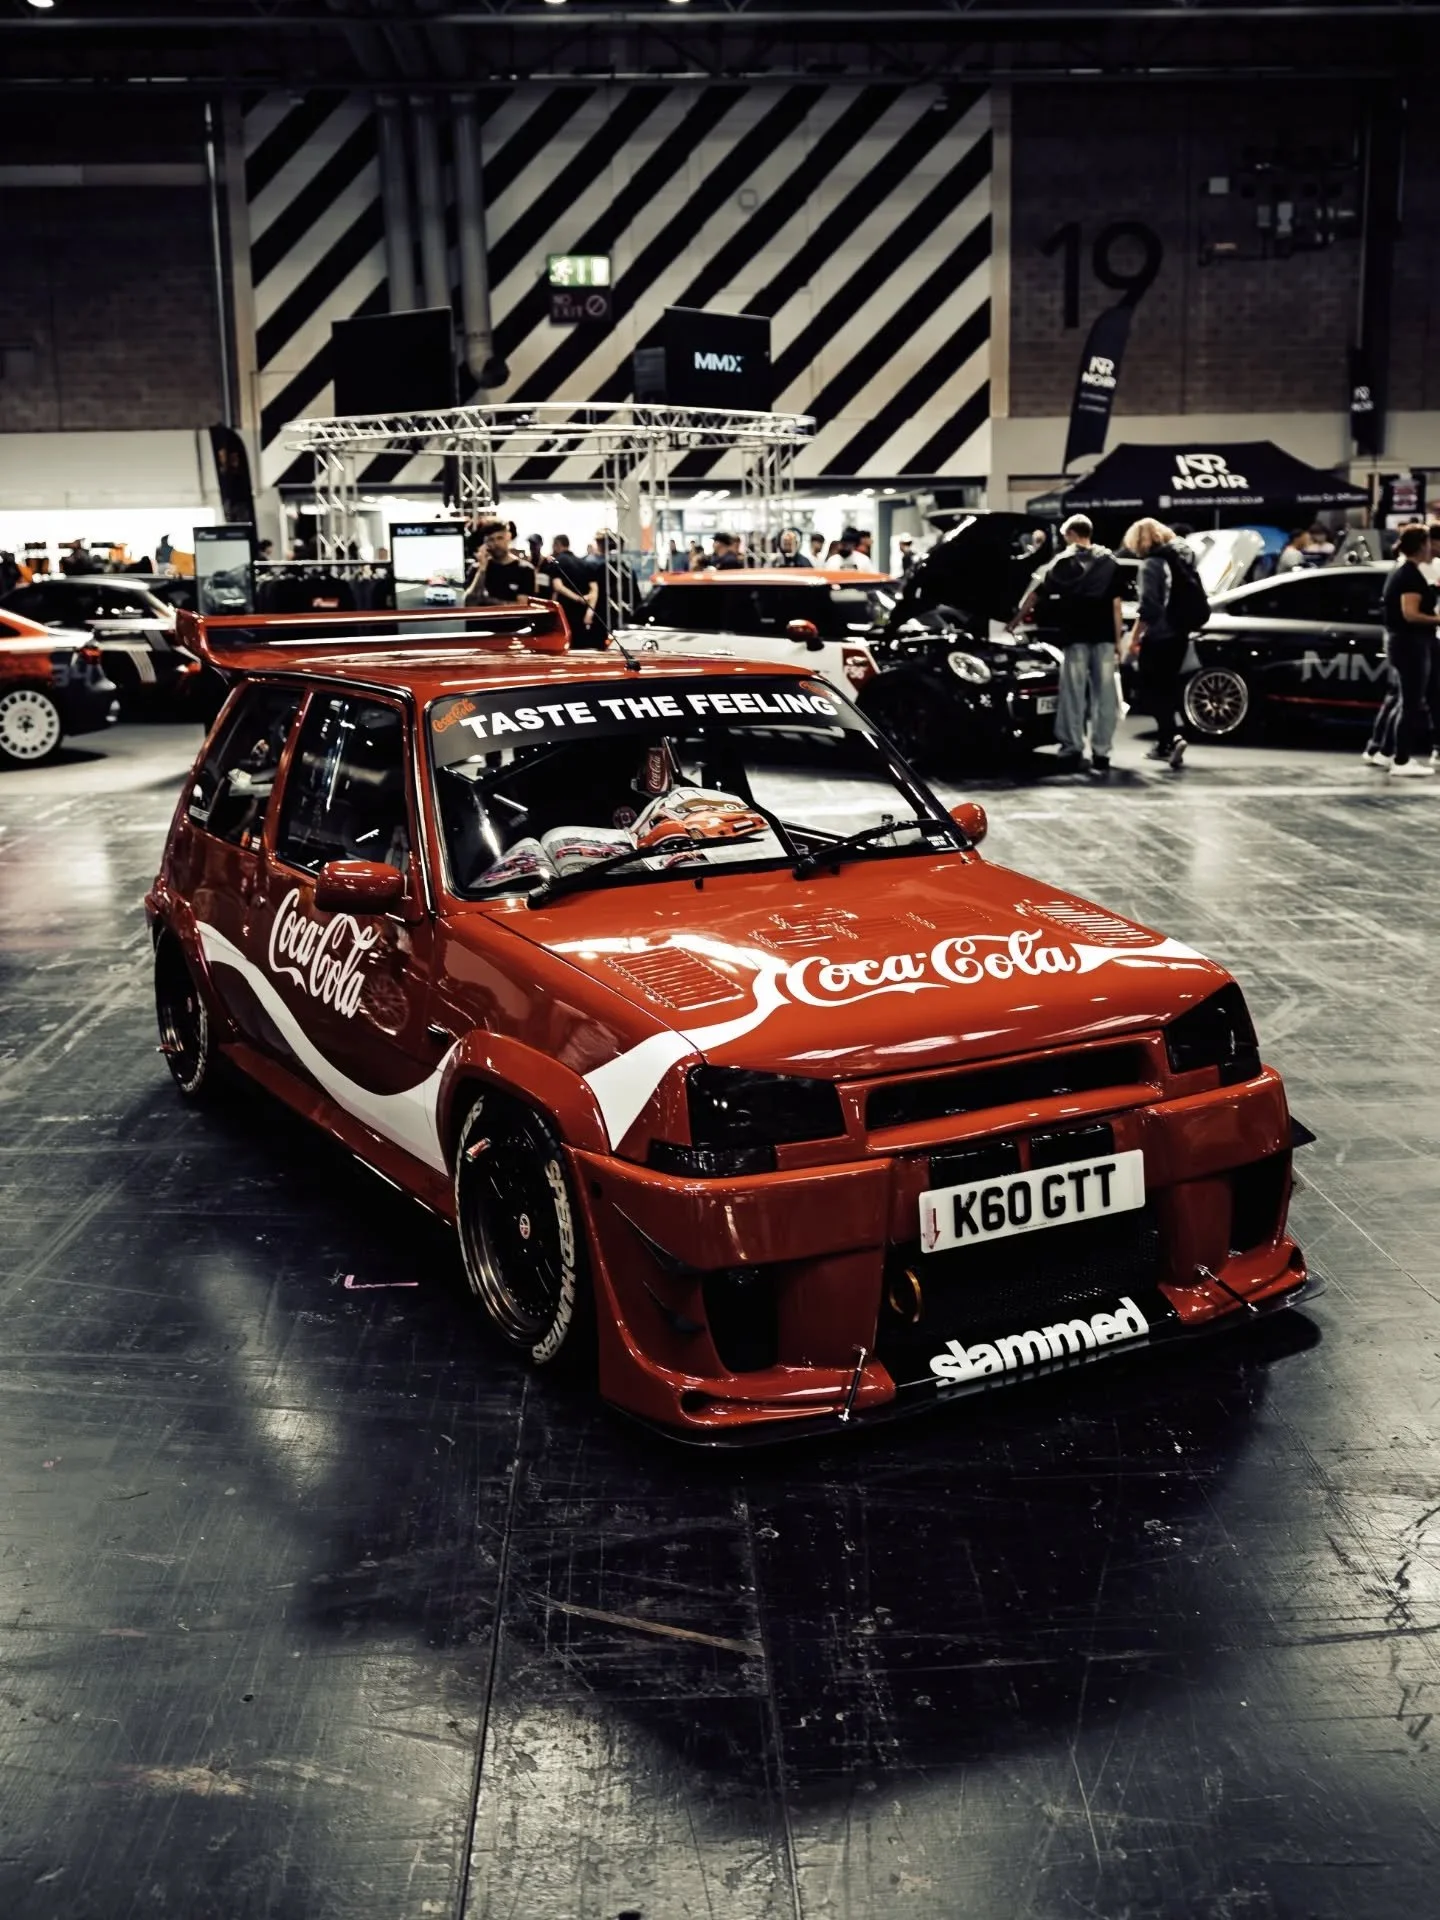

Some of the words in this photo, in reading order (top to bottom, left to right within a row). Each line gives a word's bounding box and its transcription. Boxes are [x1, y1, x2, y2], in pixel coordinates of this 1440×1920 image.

[1037, 222, 1162, 329] 19
[694, 351, 742, 373] MMX
[1171, 473, 1250, 490] NOIR
[431, 698, 477, 733] Coca-Cola
[459, 701, 598, 739] TASTE
[598, 695, 684, 721] THE
[686, 693, 838, 716] FEELING
[268, 887, 381, 1019] Coca-Cola
[786, 928, 1076, 1008] Coca-Cola
[953, 1180, 1032, 1239] K60
[1042, 1163, 1116, 1219] GTT
[929, 1296, 1150, 1388] slammed
